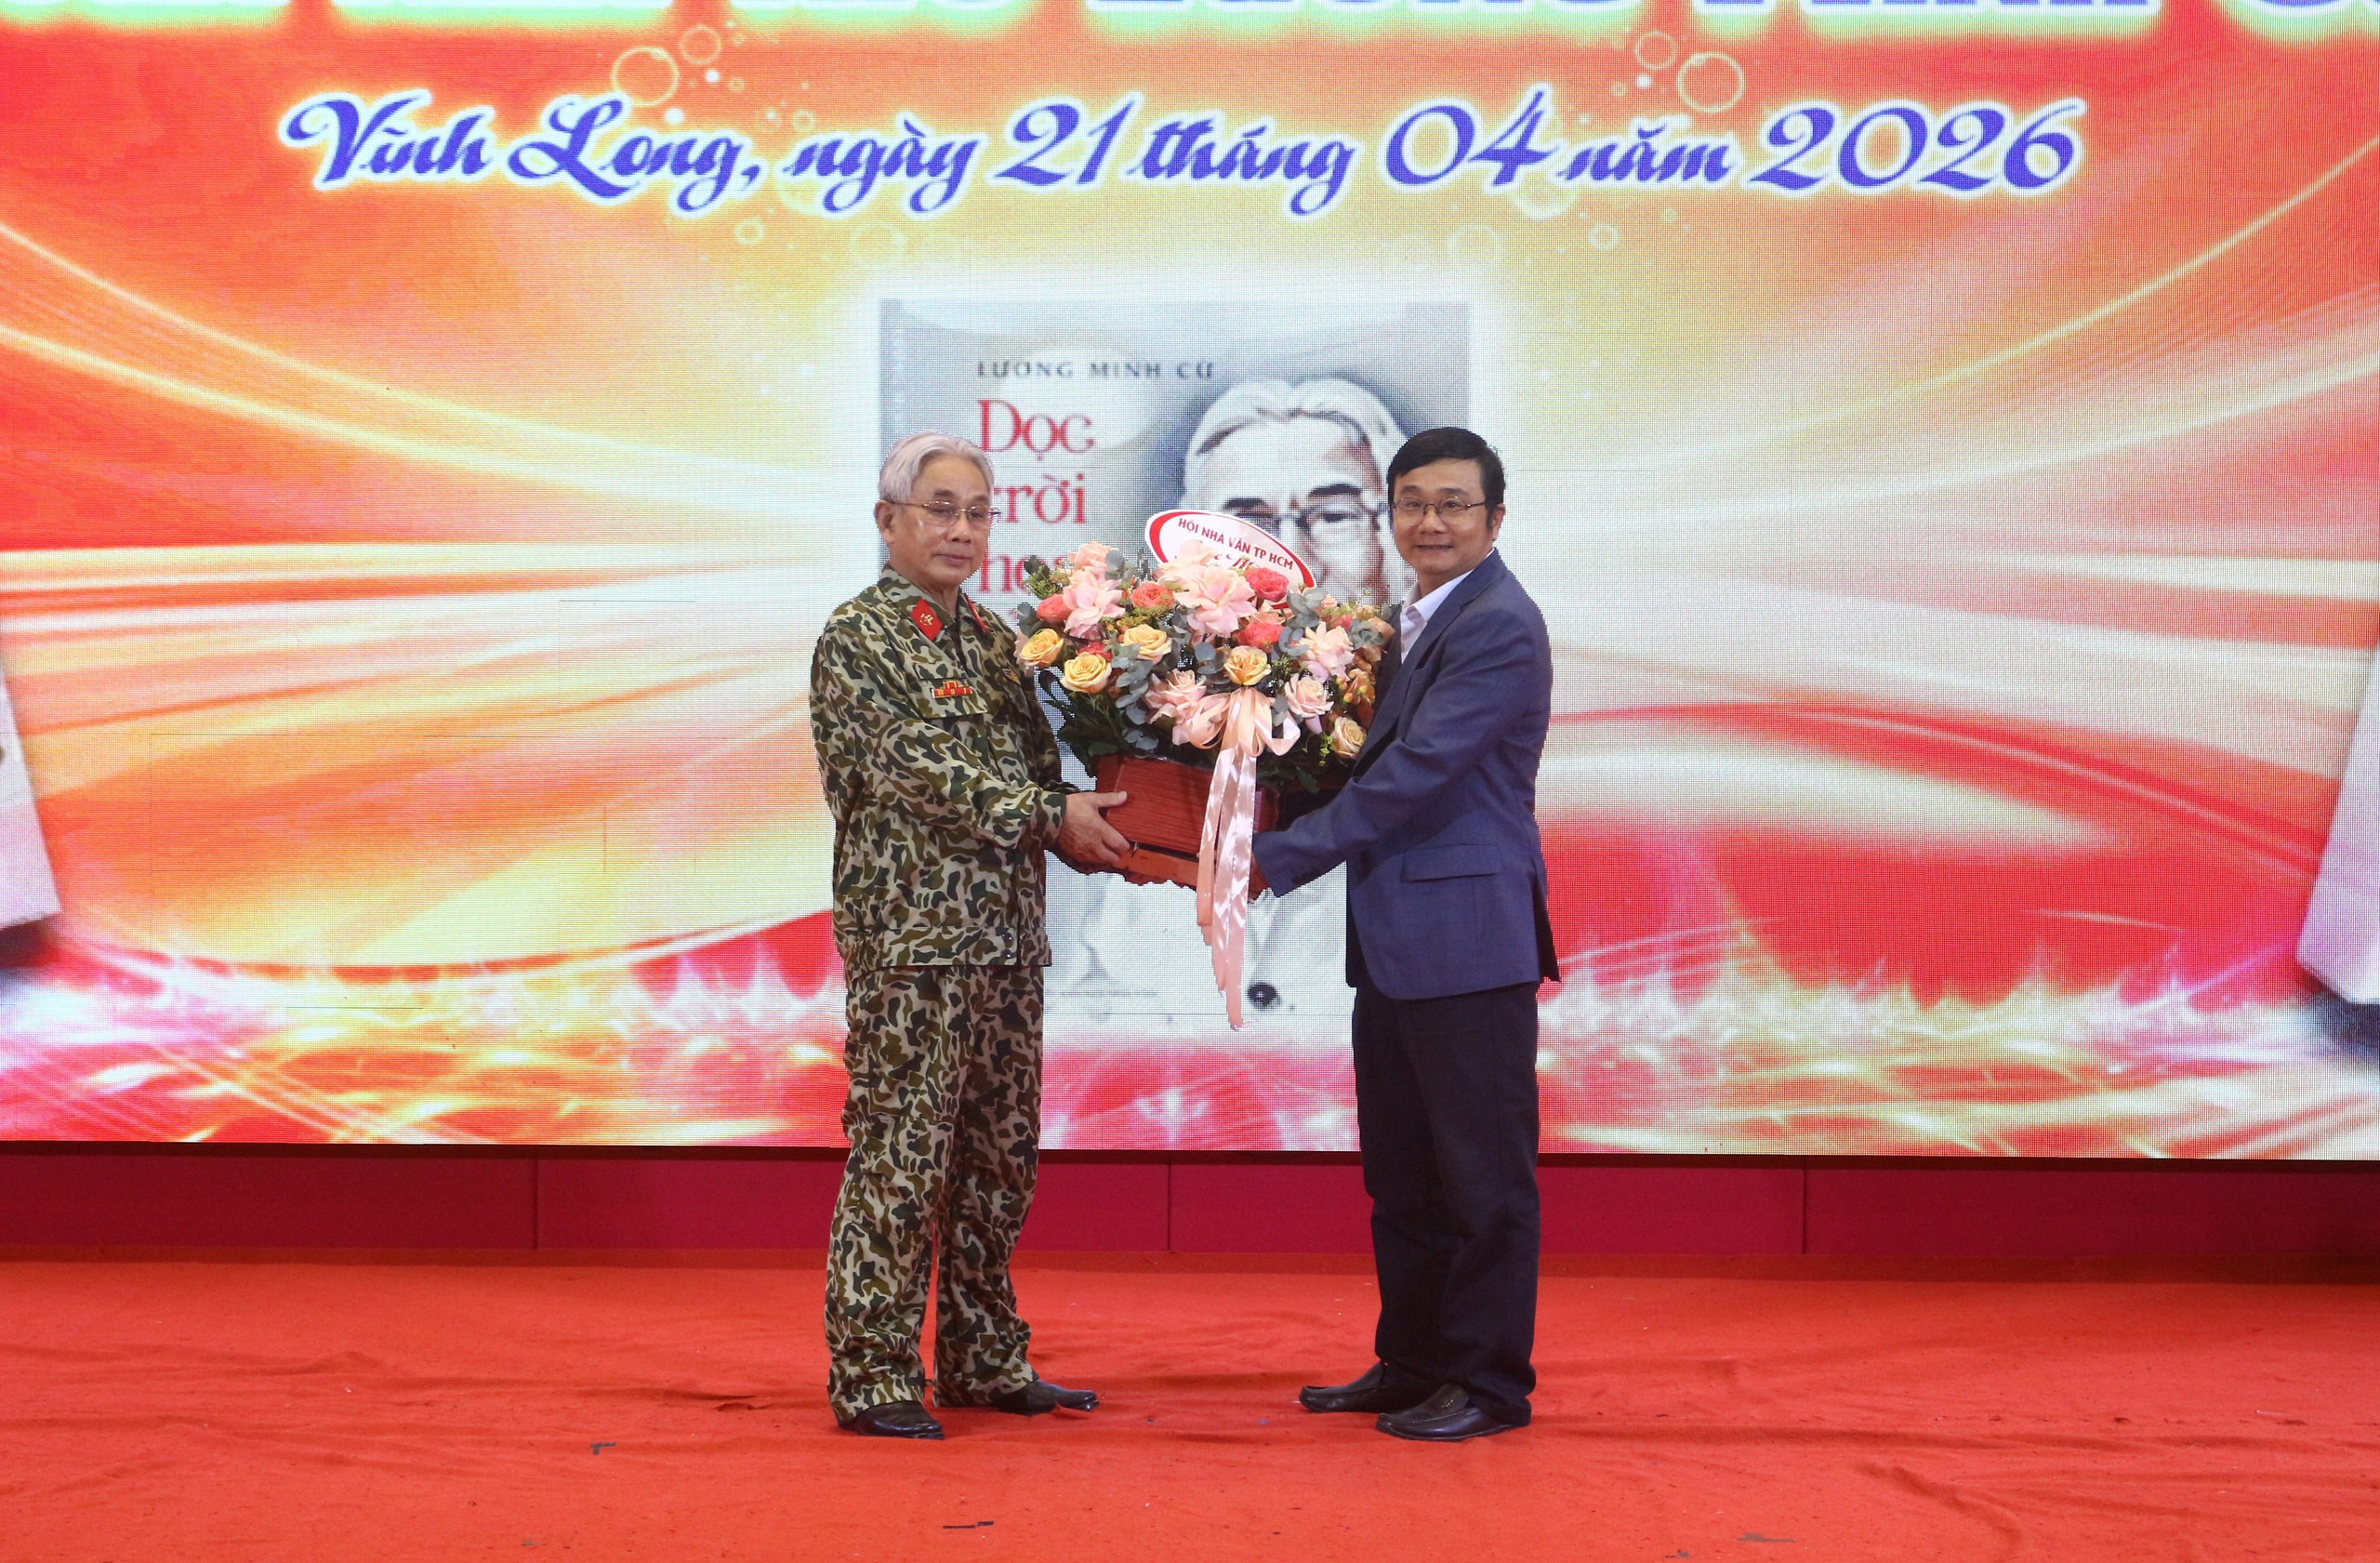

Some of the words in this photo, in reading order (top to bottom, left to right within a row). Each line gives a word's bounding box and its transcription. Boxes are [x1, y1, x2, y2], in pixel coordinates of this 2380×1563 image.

[508, 98, 761, 213] Long,
[784, 113, 980, 214] ngày
[996, 100, 1134, 187] 21
[1127, 118, 1355, 216] tháng
[1385, 90, 1560, 187] 04
[1556, 126, 1733, 183] năm
[1751, 105, 2082, 192] 2026
[1090, 361, 1162, 378] MINH
[977, 399, 1095, 461] Dọc
[990, 472, 1087, 524] rời
[1178, 517, 1199, 533] HỘI
[1201, 526, 1224, 544] NHÀ
[1228, 536, 1251, 554] VĂN
[1254, 546, 1267, 559] TP
[1269, 552, 1294, 570] HCM
